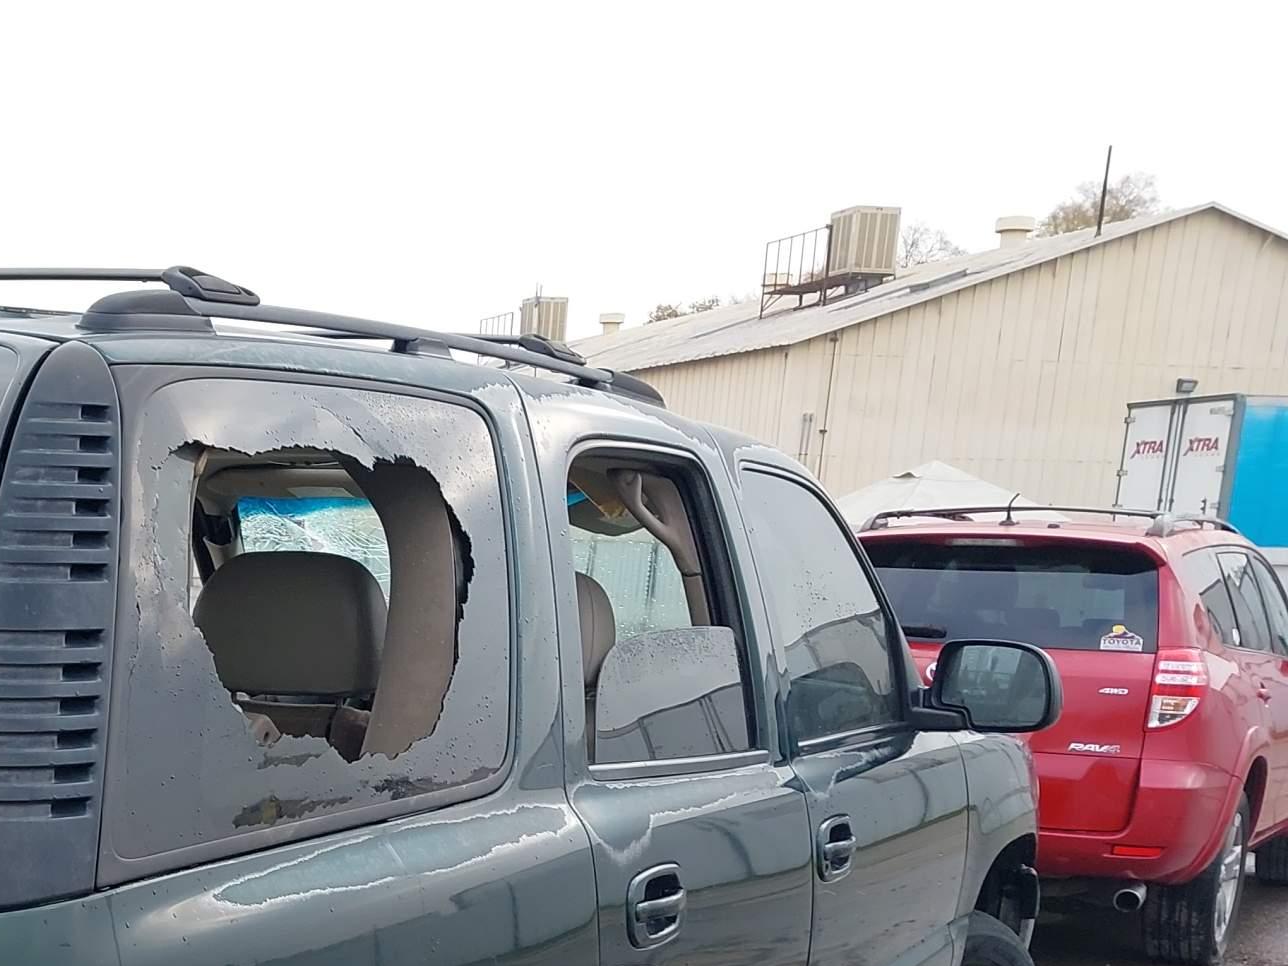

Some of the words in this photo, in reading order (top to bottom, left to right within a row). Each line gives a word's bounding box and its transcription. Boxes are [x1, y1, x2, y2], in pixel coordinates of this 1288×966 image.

[1130, 440, 1163, 459] XTRA
[1182, 437, 1219, 456] XTRA
[1102, 638, 1142, 647] TOYOTA
[1098, 687, 1129, 695] 4WD
[1068, 742, 1121, 753] RAV4
